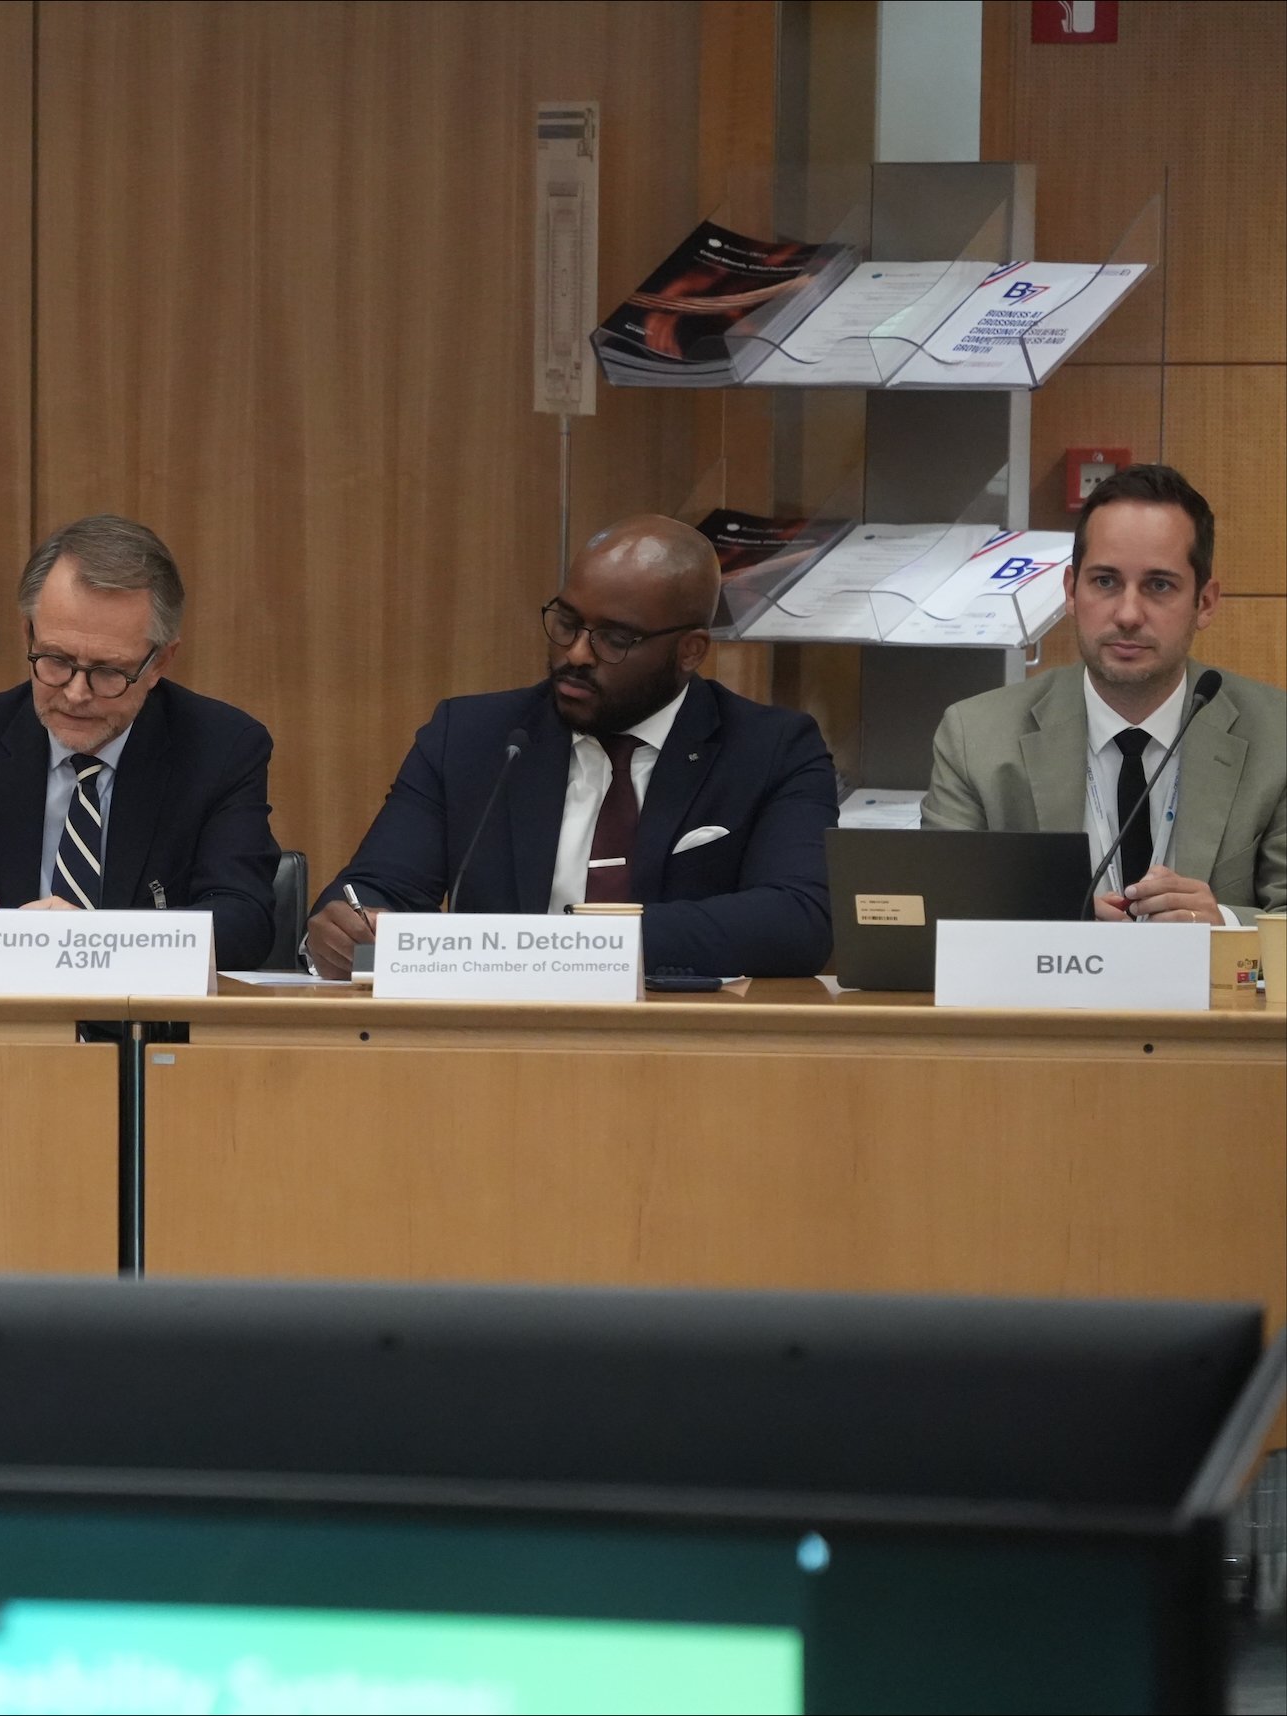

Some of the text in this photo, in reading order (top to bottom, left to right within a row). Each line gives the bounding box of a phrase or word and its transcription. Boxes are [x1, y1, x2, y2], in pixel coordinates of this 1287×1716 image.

[985, 309, 1031, 318] BUSINESS
[58, 929, 197, 952] Jacquemin
[397, 931, 624, 955] Bryan N. Detchou
[55, 950, 111, 969] A3M
[390, 960, 630, 973] Canadian Chamber of Commerce
[1036, 954, 1104, 975] BIAC
